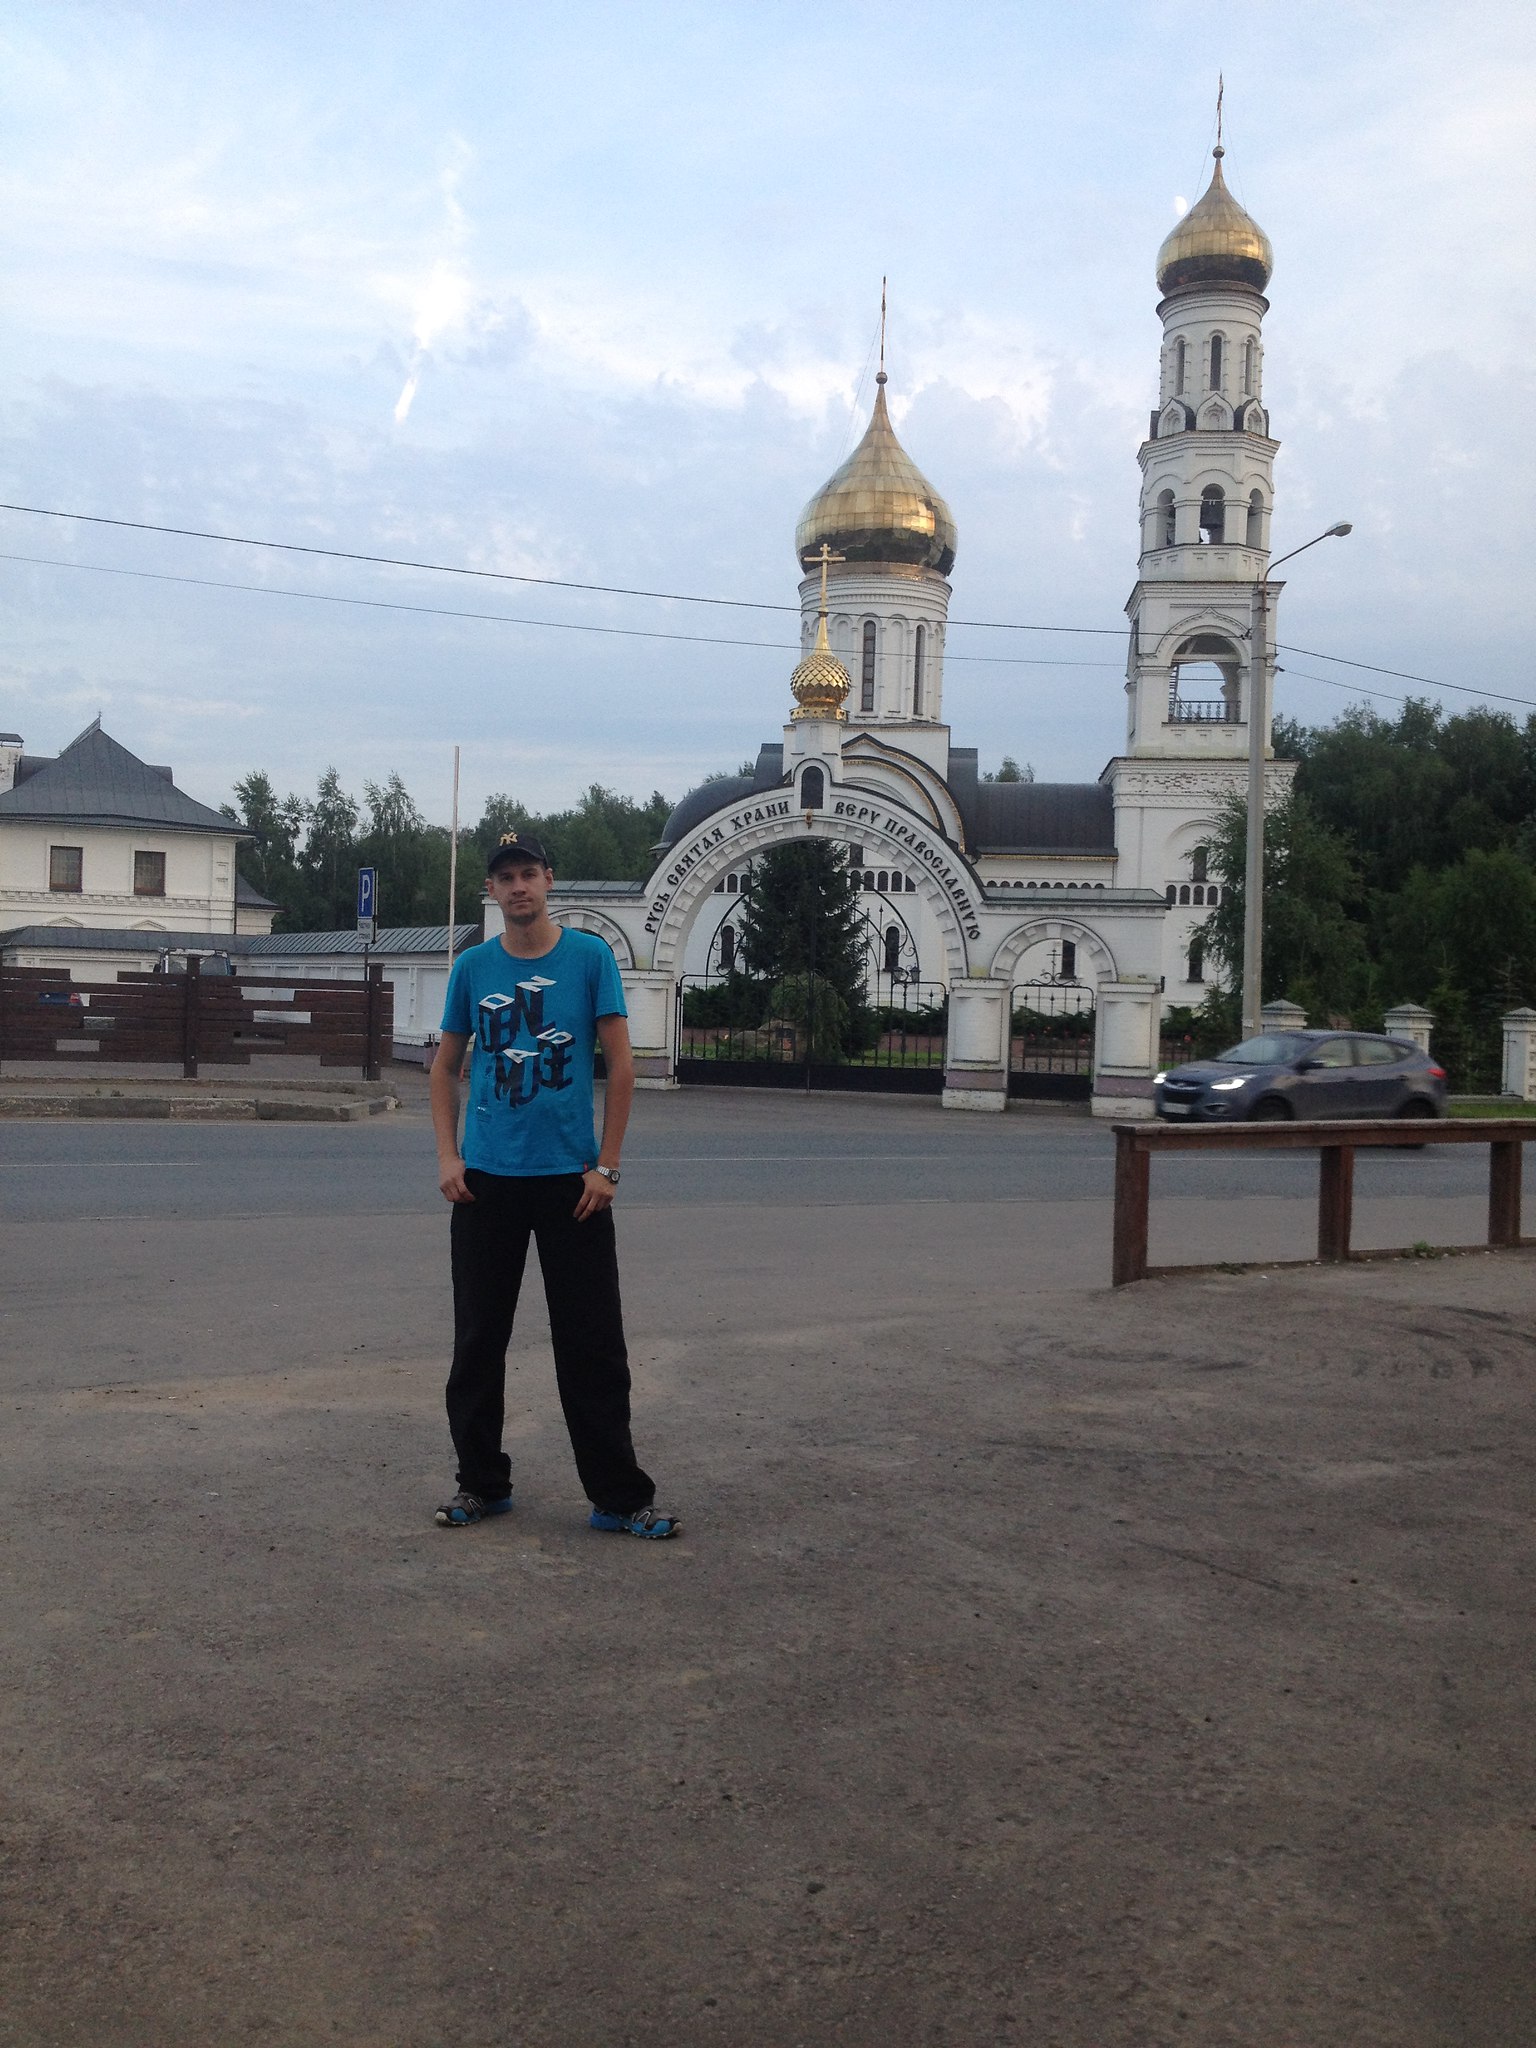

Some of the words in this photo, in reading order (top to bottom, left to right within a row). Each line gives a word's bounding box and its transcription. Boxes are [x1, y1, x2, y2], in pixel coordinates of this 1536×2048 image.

[645, 893, 670, 934] РУСЬ
[667, 828, 725, 886] СВЯТАЯ
[731, 801, 790, 830] ХРАНИ
[834, 801, 879, 824] ВЕРУ
[884, 818, 980, 938] ПРАВОСЛАВНУЮ
